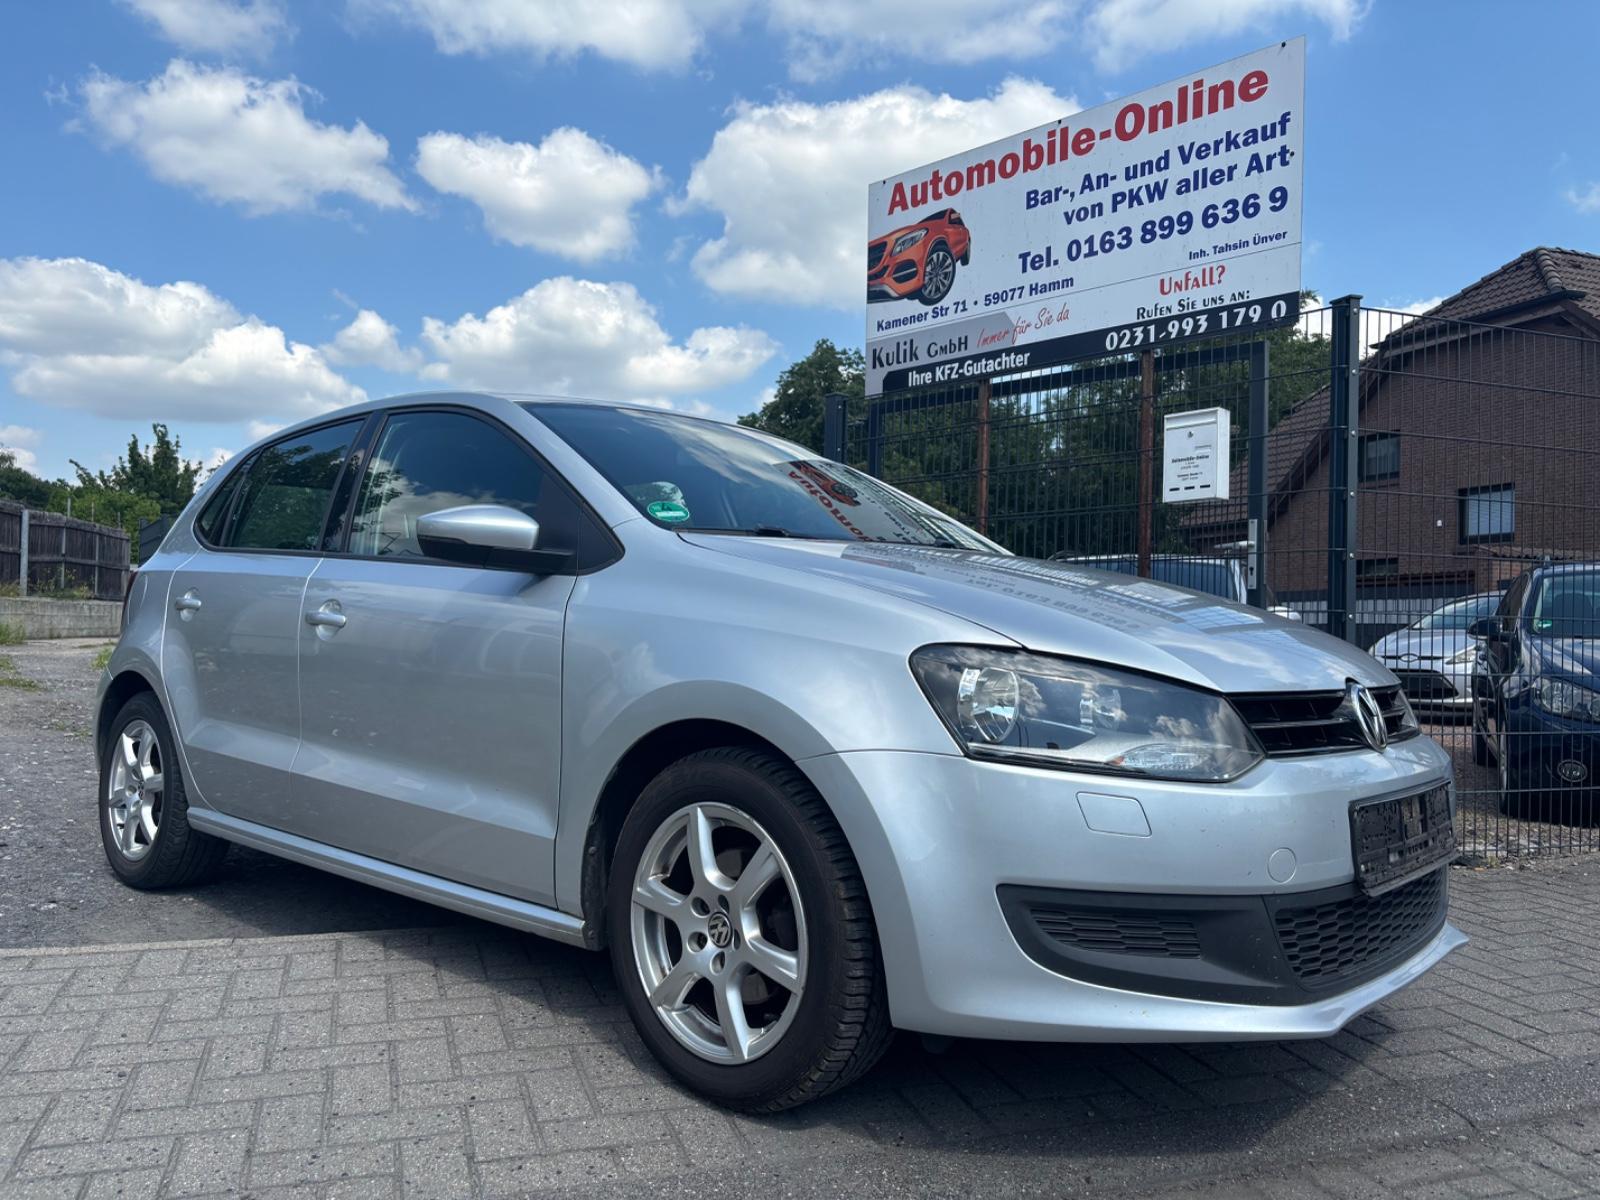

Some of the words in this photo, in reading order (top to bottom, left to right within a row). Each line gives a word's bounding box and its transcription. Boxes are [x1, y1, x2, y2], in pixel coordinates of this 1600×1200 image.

[888, 70, 1269, 215] Automobile-Online
[1079, 171, 1117, 195] An-
[1125, 149, 1170, 181] und
[1178, 111, 1291, 167] Verkauf
[1064, 202, 1103, 225] von
[1112, 179, 1168, 213] PKW
[1176, 164, 1238, 196] aller
[1018, 247, 1059, 274] Tel.
[1067, 226, 1133, 262] 0163
[1140, 211, 1193, 244] 899
[1189, 249, 1209, 261] Inh.
[1212, 239, 1249, 255] Tahsin
[1252, 231, 1288, 246] Ünver
[876, 311, 929, 332] Kamener
[931, 304, 949, 319] Str
[953, 300, 968, 315] 71
[984, 286, 1025, 307] 59077
[1029, 276, 1074, 297] Hamm
[976, 328, 1010, 348] Immer
[1011, 315, 1033, 345] für
[1035, 307, 1054, 330] Sie
[1056, 302, 1070, 322] da
[872, 338, 919, 370] Kulik
[908, 370, 932, 387] Ihre
[935, 351, 1030, 383] KFZ-Gutachter
